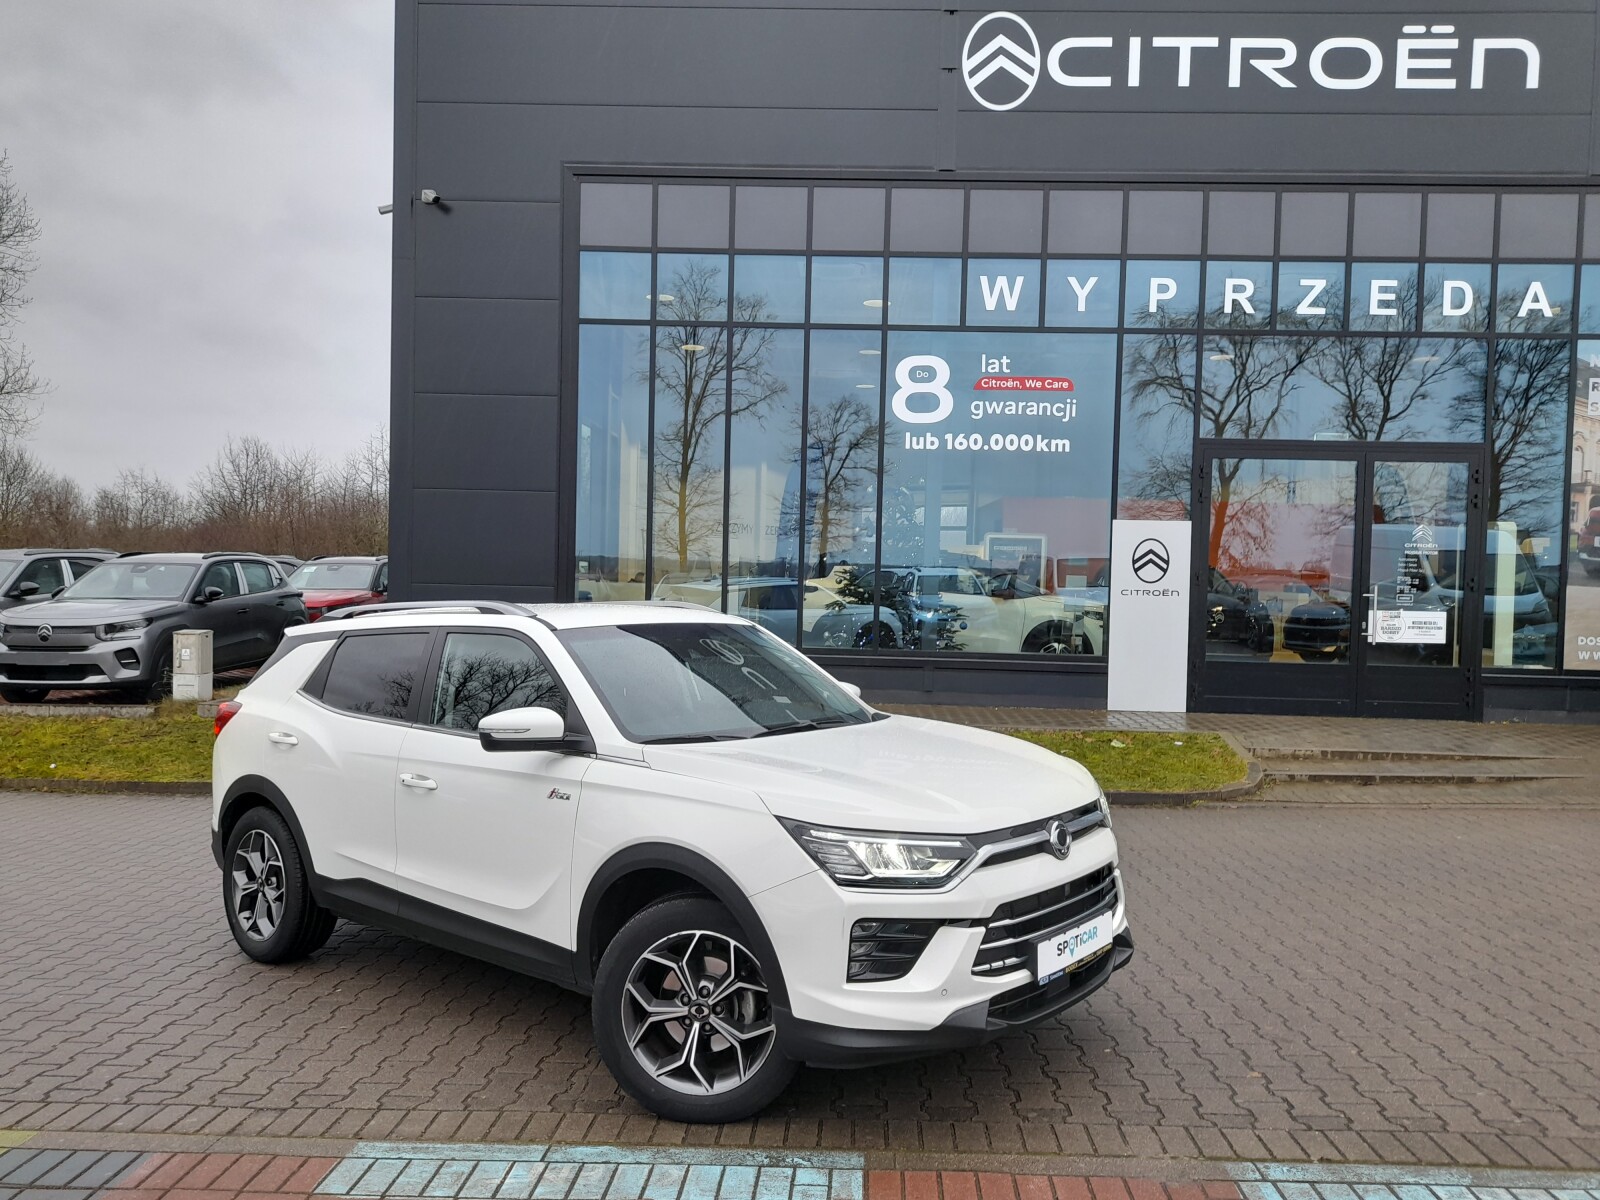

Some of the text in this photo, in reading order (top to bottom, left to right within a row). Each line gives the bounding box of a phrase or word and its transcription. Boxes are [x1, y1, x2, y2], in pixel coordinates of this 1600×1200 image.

[1047, 25, 1541, 90] CITROËN
[981, 353, 1011, 373] lat
[915, 369, 930, 378] Do
[980, 377, 1069, 389] Citroën, We Care
[891, 354, 954, 424] 8
[970, 398, 1077, 422] gwarancji
[905, 431, 940, 450] lub
[1120, 588, 1180, 597] CITROËN
